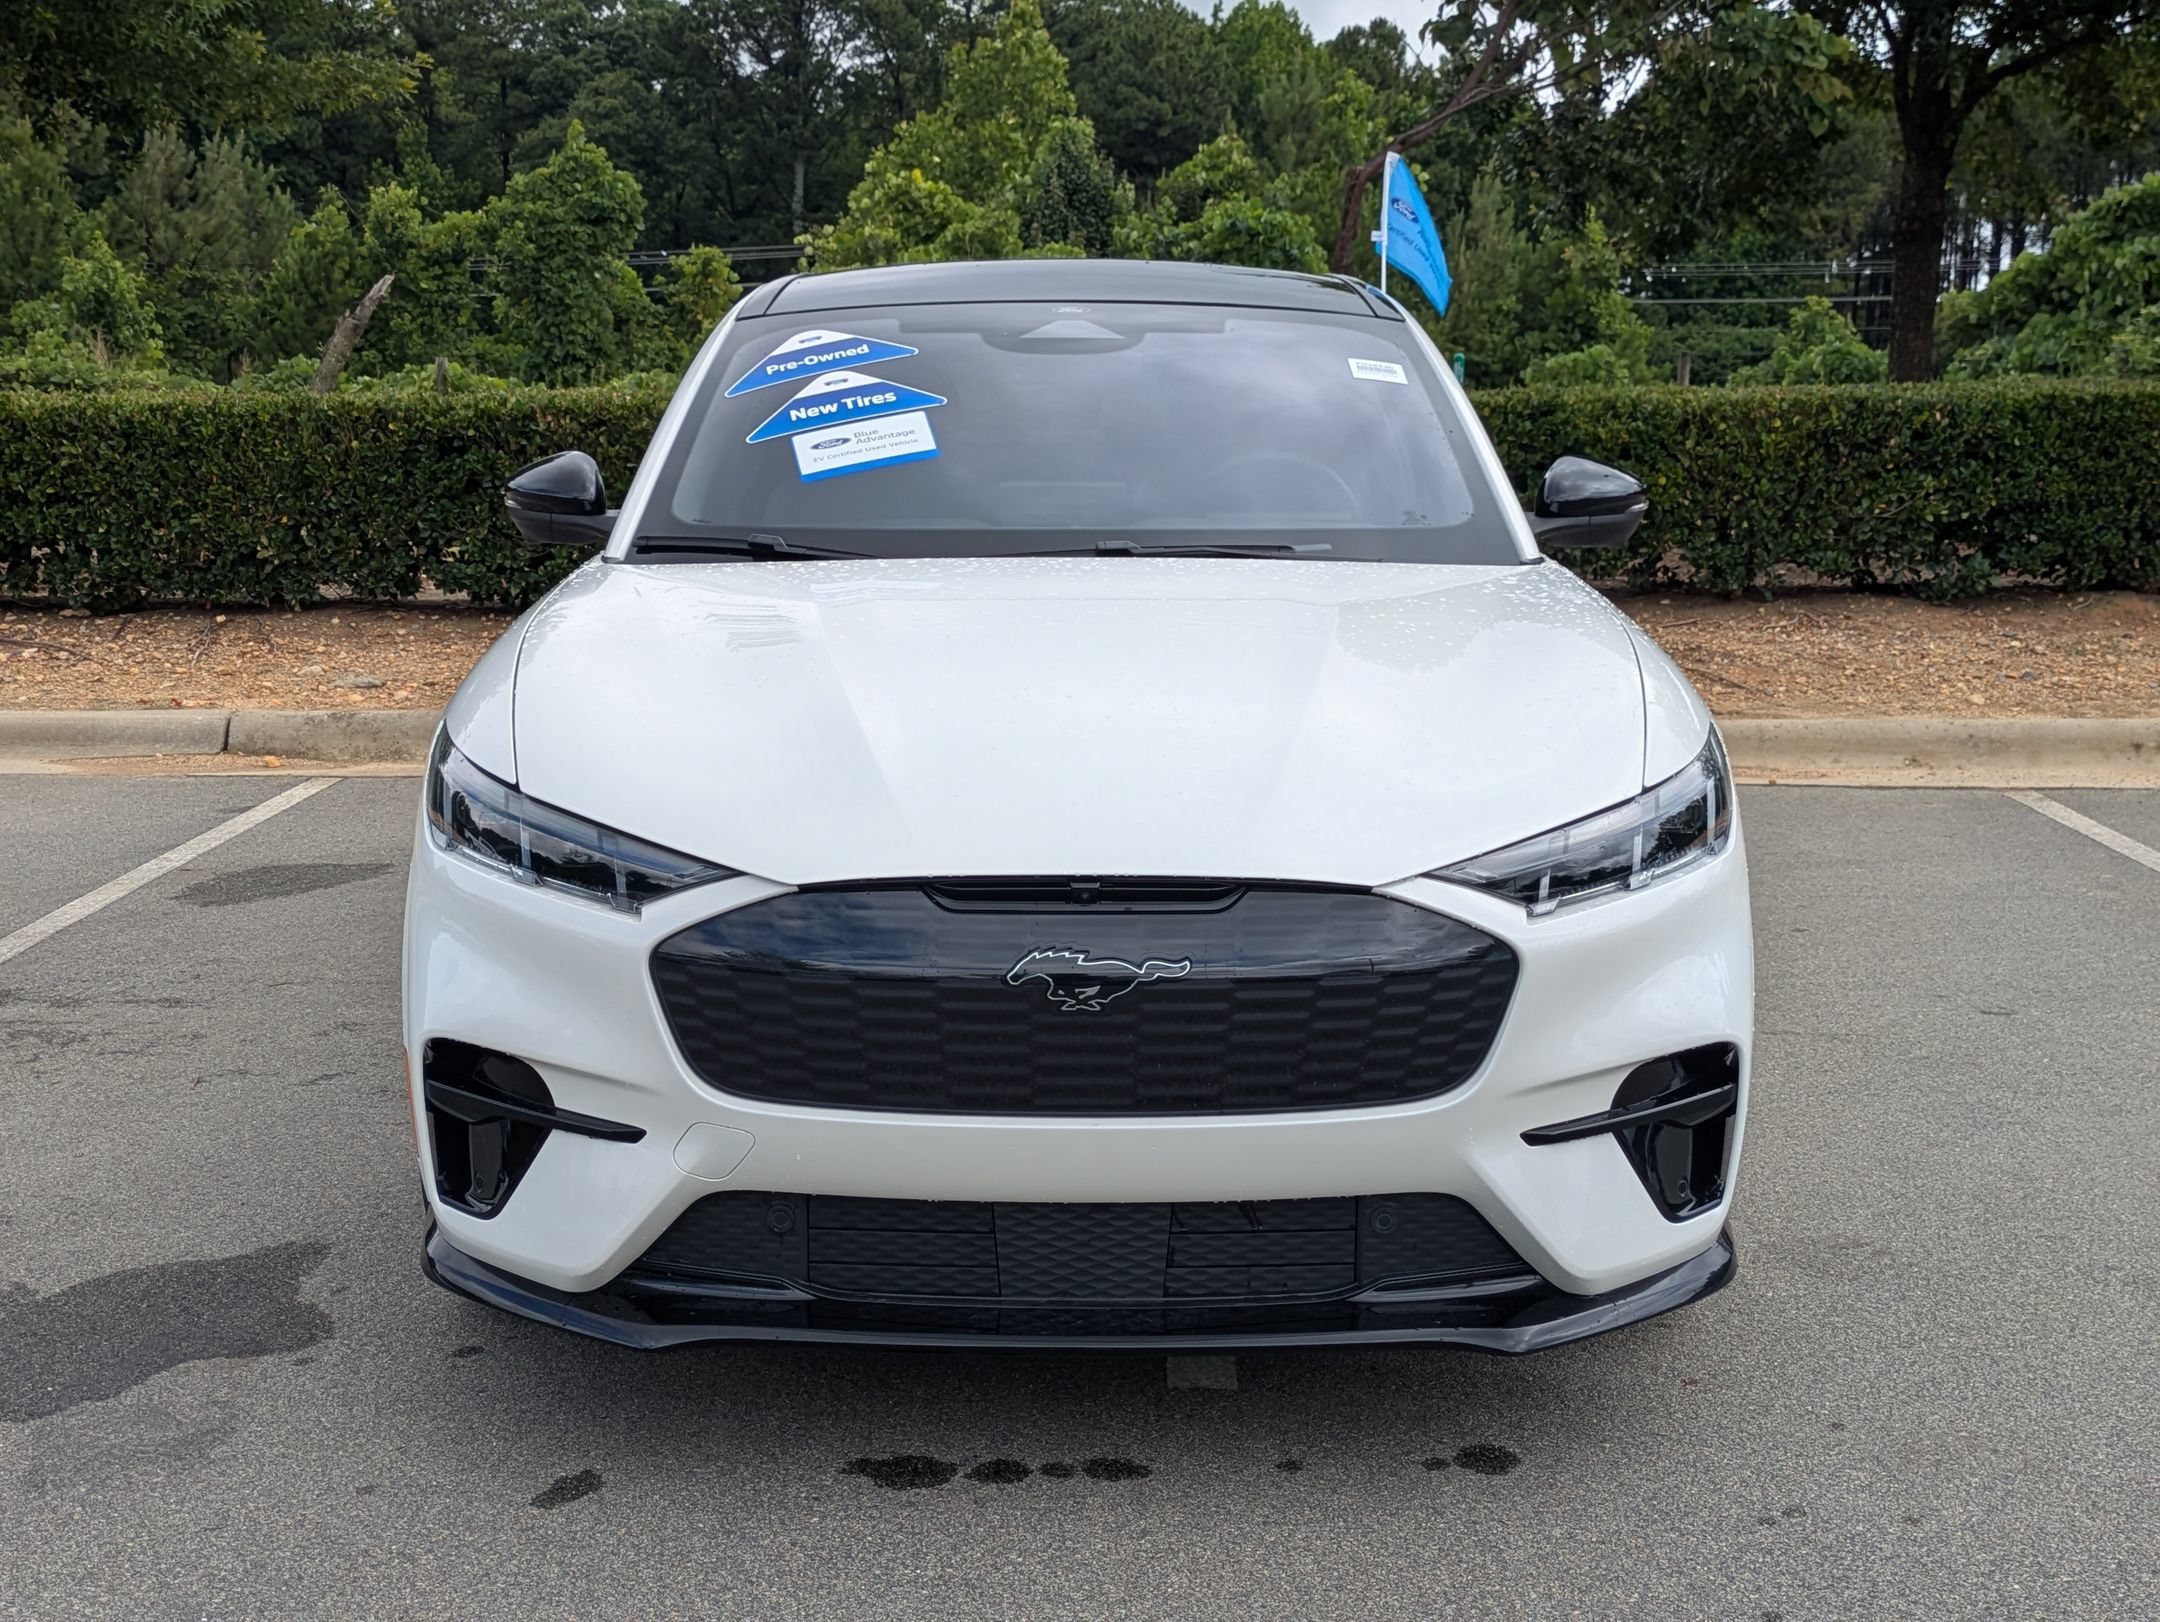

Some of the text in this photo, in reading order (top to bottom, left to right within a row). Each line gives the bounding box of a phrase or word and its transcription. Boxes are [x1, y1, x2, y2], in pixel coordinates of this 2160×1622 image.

[1394, 200, 1415, 219] Ford
[766, 344, 870, 375] Pre-Owned
[789, 391, 897, 421] New Tires
[854, 429, 879, 438] Blue
[856, 429, 916, 444] Advantage
[818, 440, 844, 449] Ford
[827, 449, 862, 460] Certified
[889, 438, 918, 447] Vehicle
